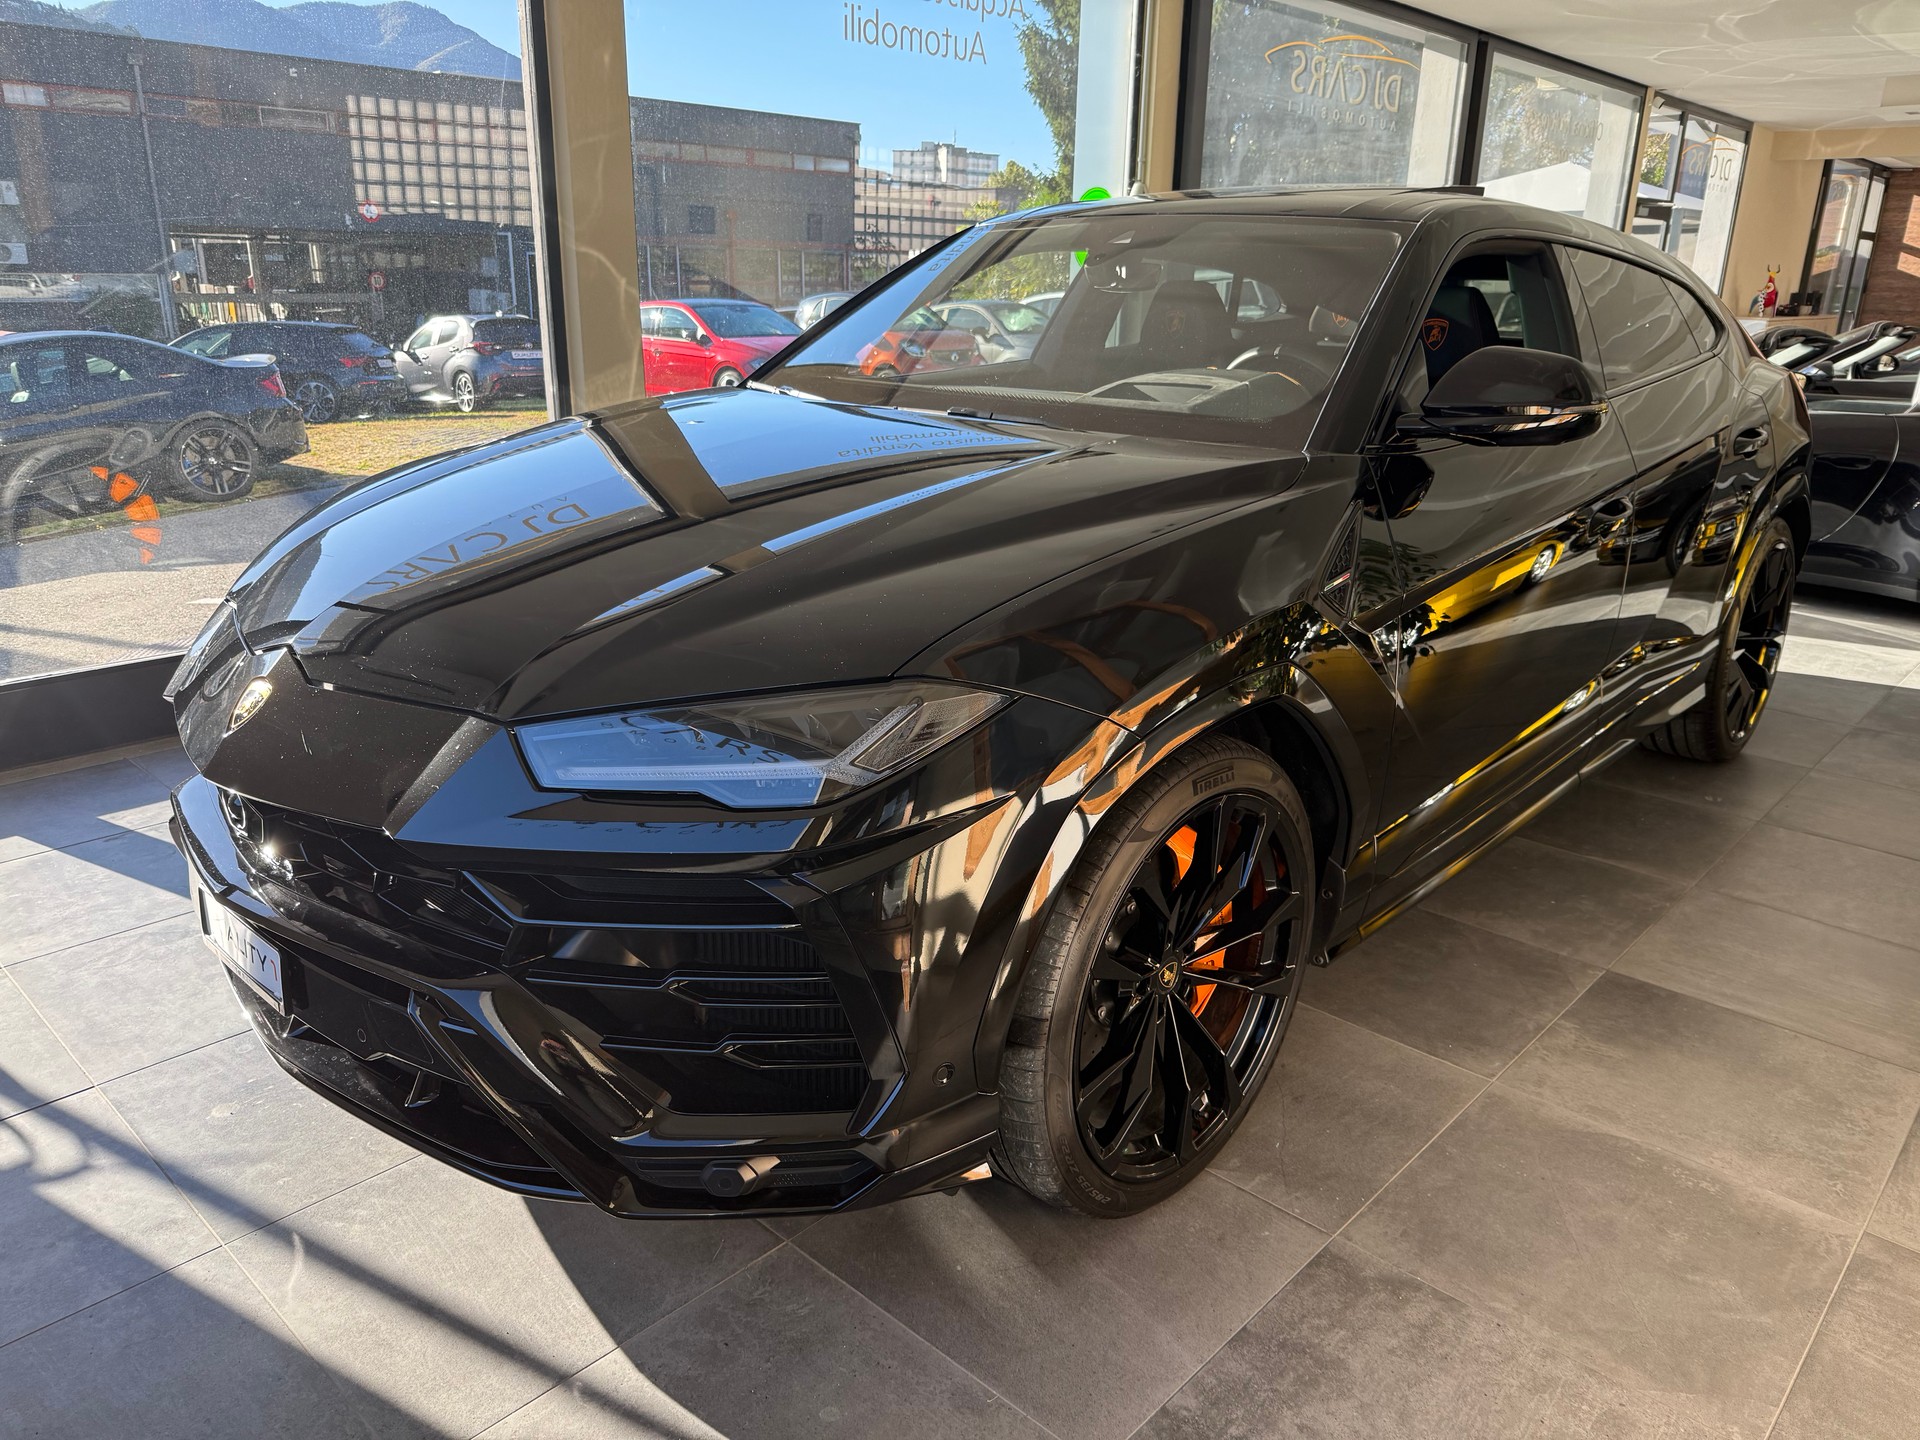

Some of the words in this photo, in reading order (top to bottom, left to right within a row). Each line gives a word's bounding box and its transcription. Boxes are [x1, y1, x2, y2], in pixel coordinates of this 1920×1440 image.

[837, 442, 923, 457] Vendita
[1191, 765, 1235, 797] PIRELLI
[1075, 1175, 1112, 1204] 285/35
